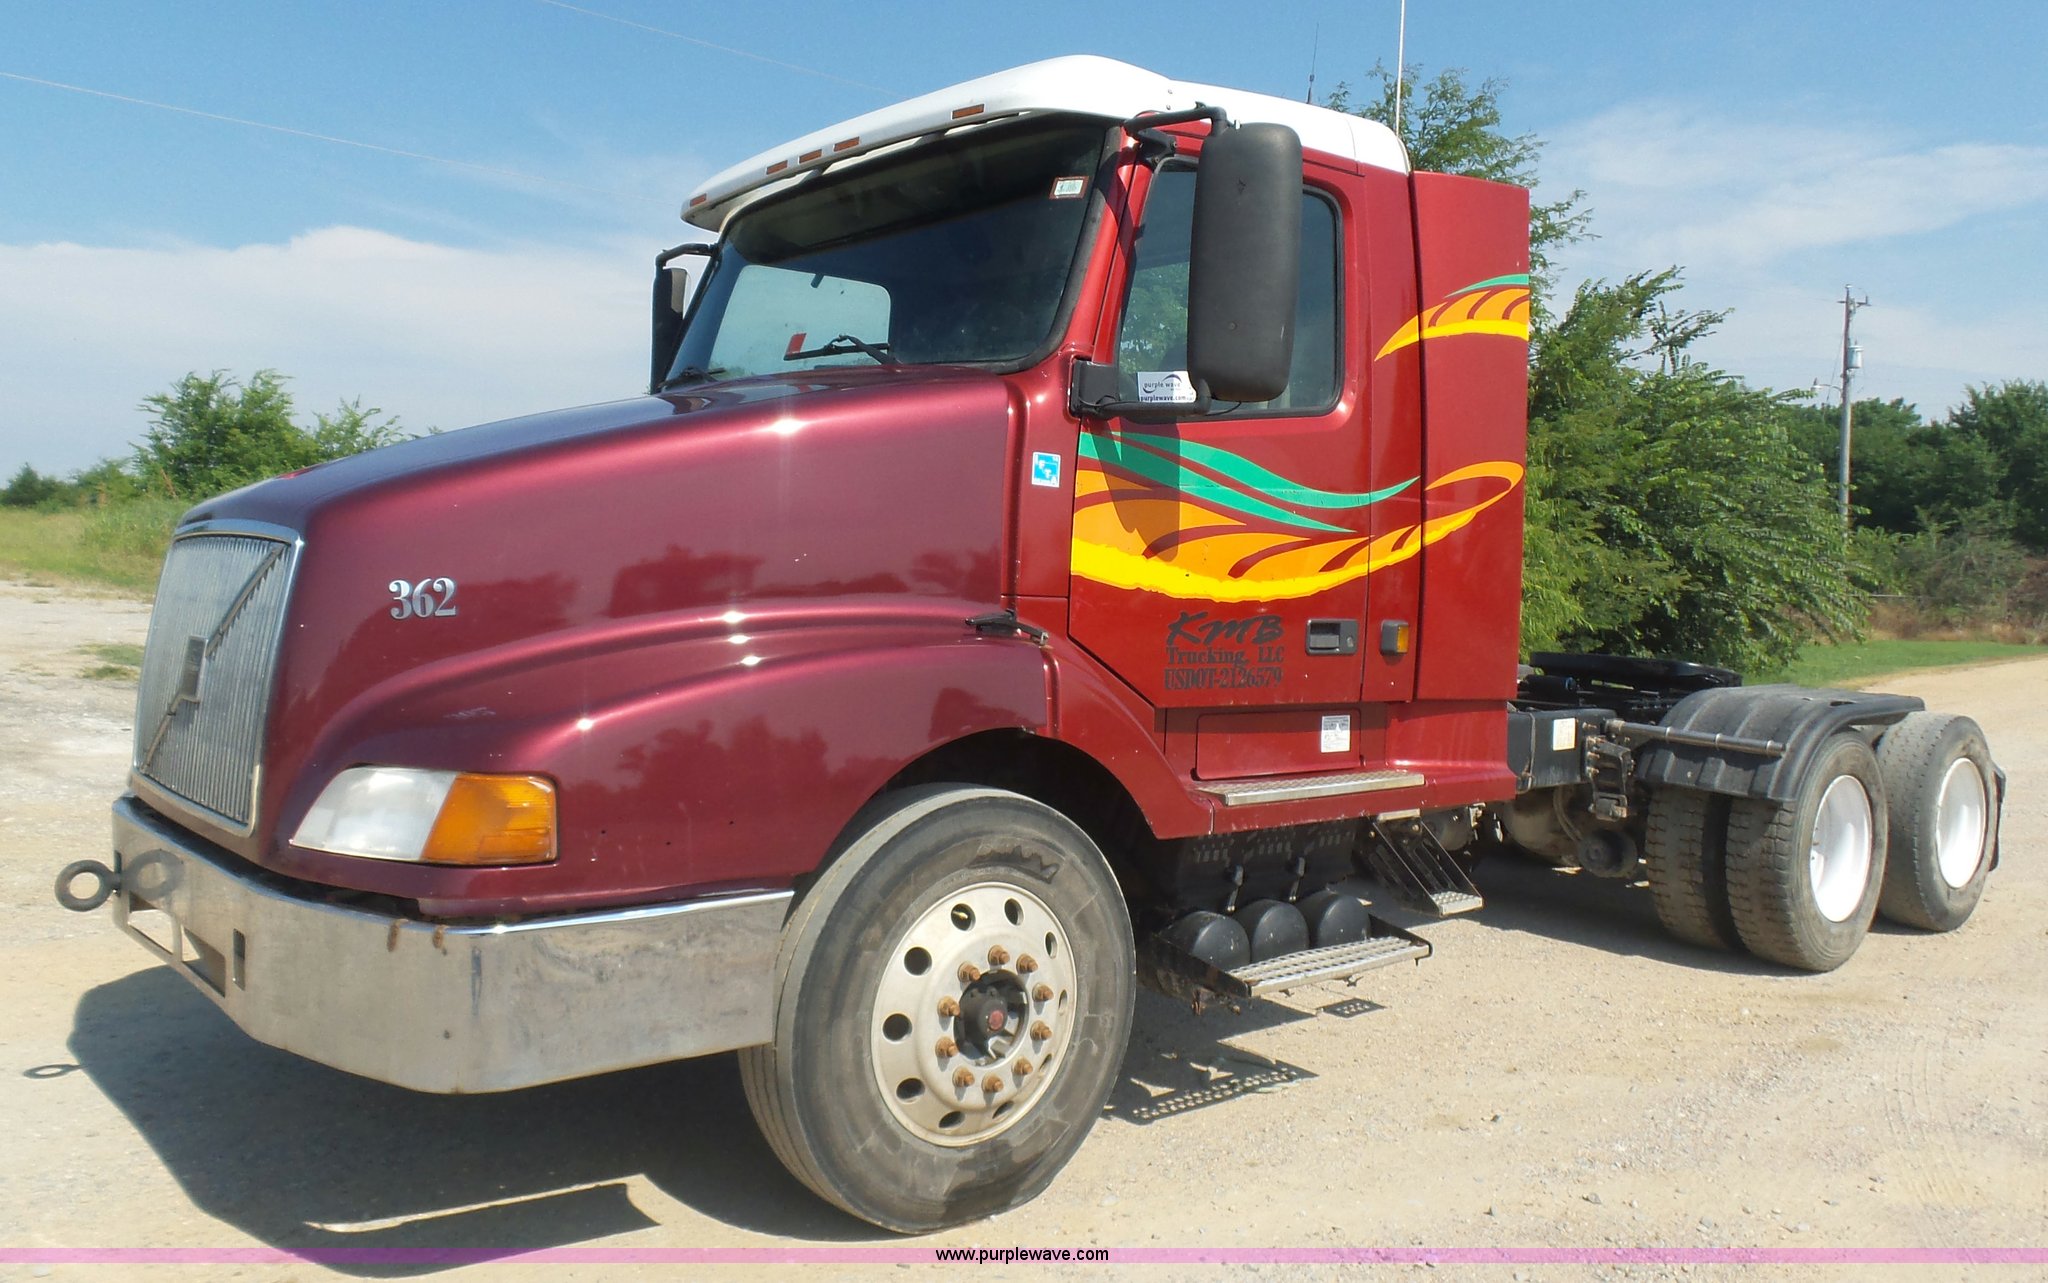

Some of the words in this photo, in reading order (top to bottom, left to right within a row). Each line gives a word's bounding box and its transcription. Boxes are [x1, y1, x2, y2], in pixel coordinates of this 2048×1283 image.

[1143, 381, 1164, 389] purple
[388, 577, 457, 620] 362
[1257, 646, 1285, 663] LLC
